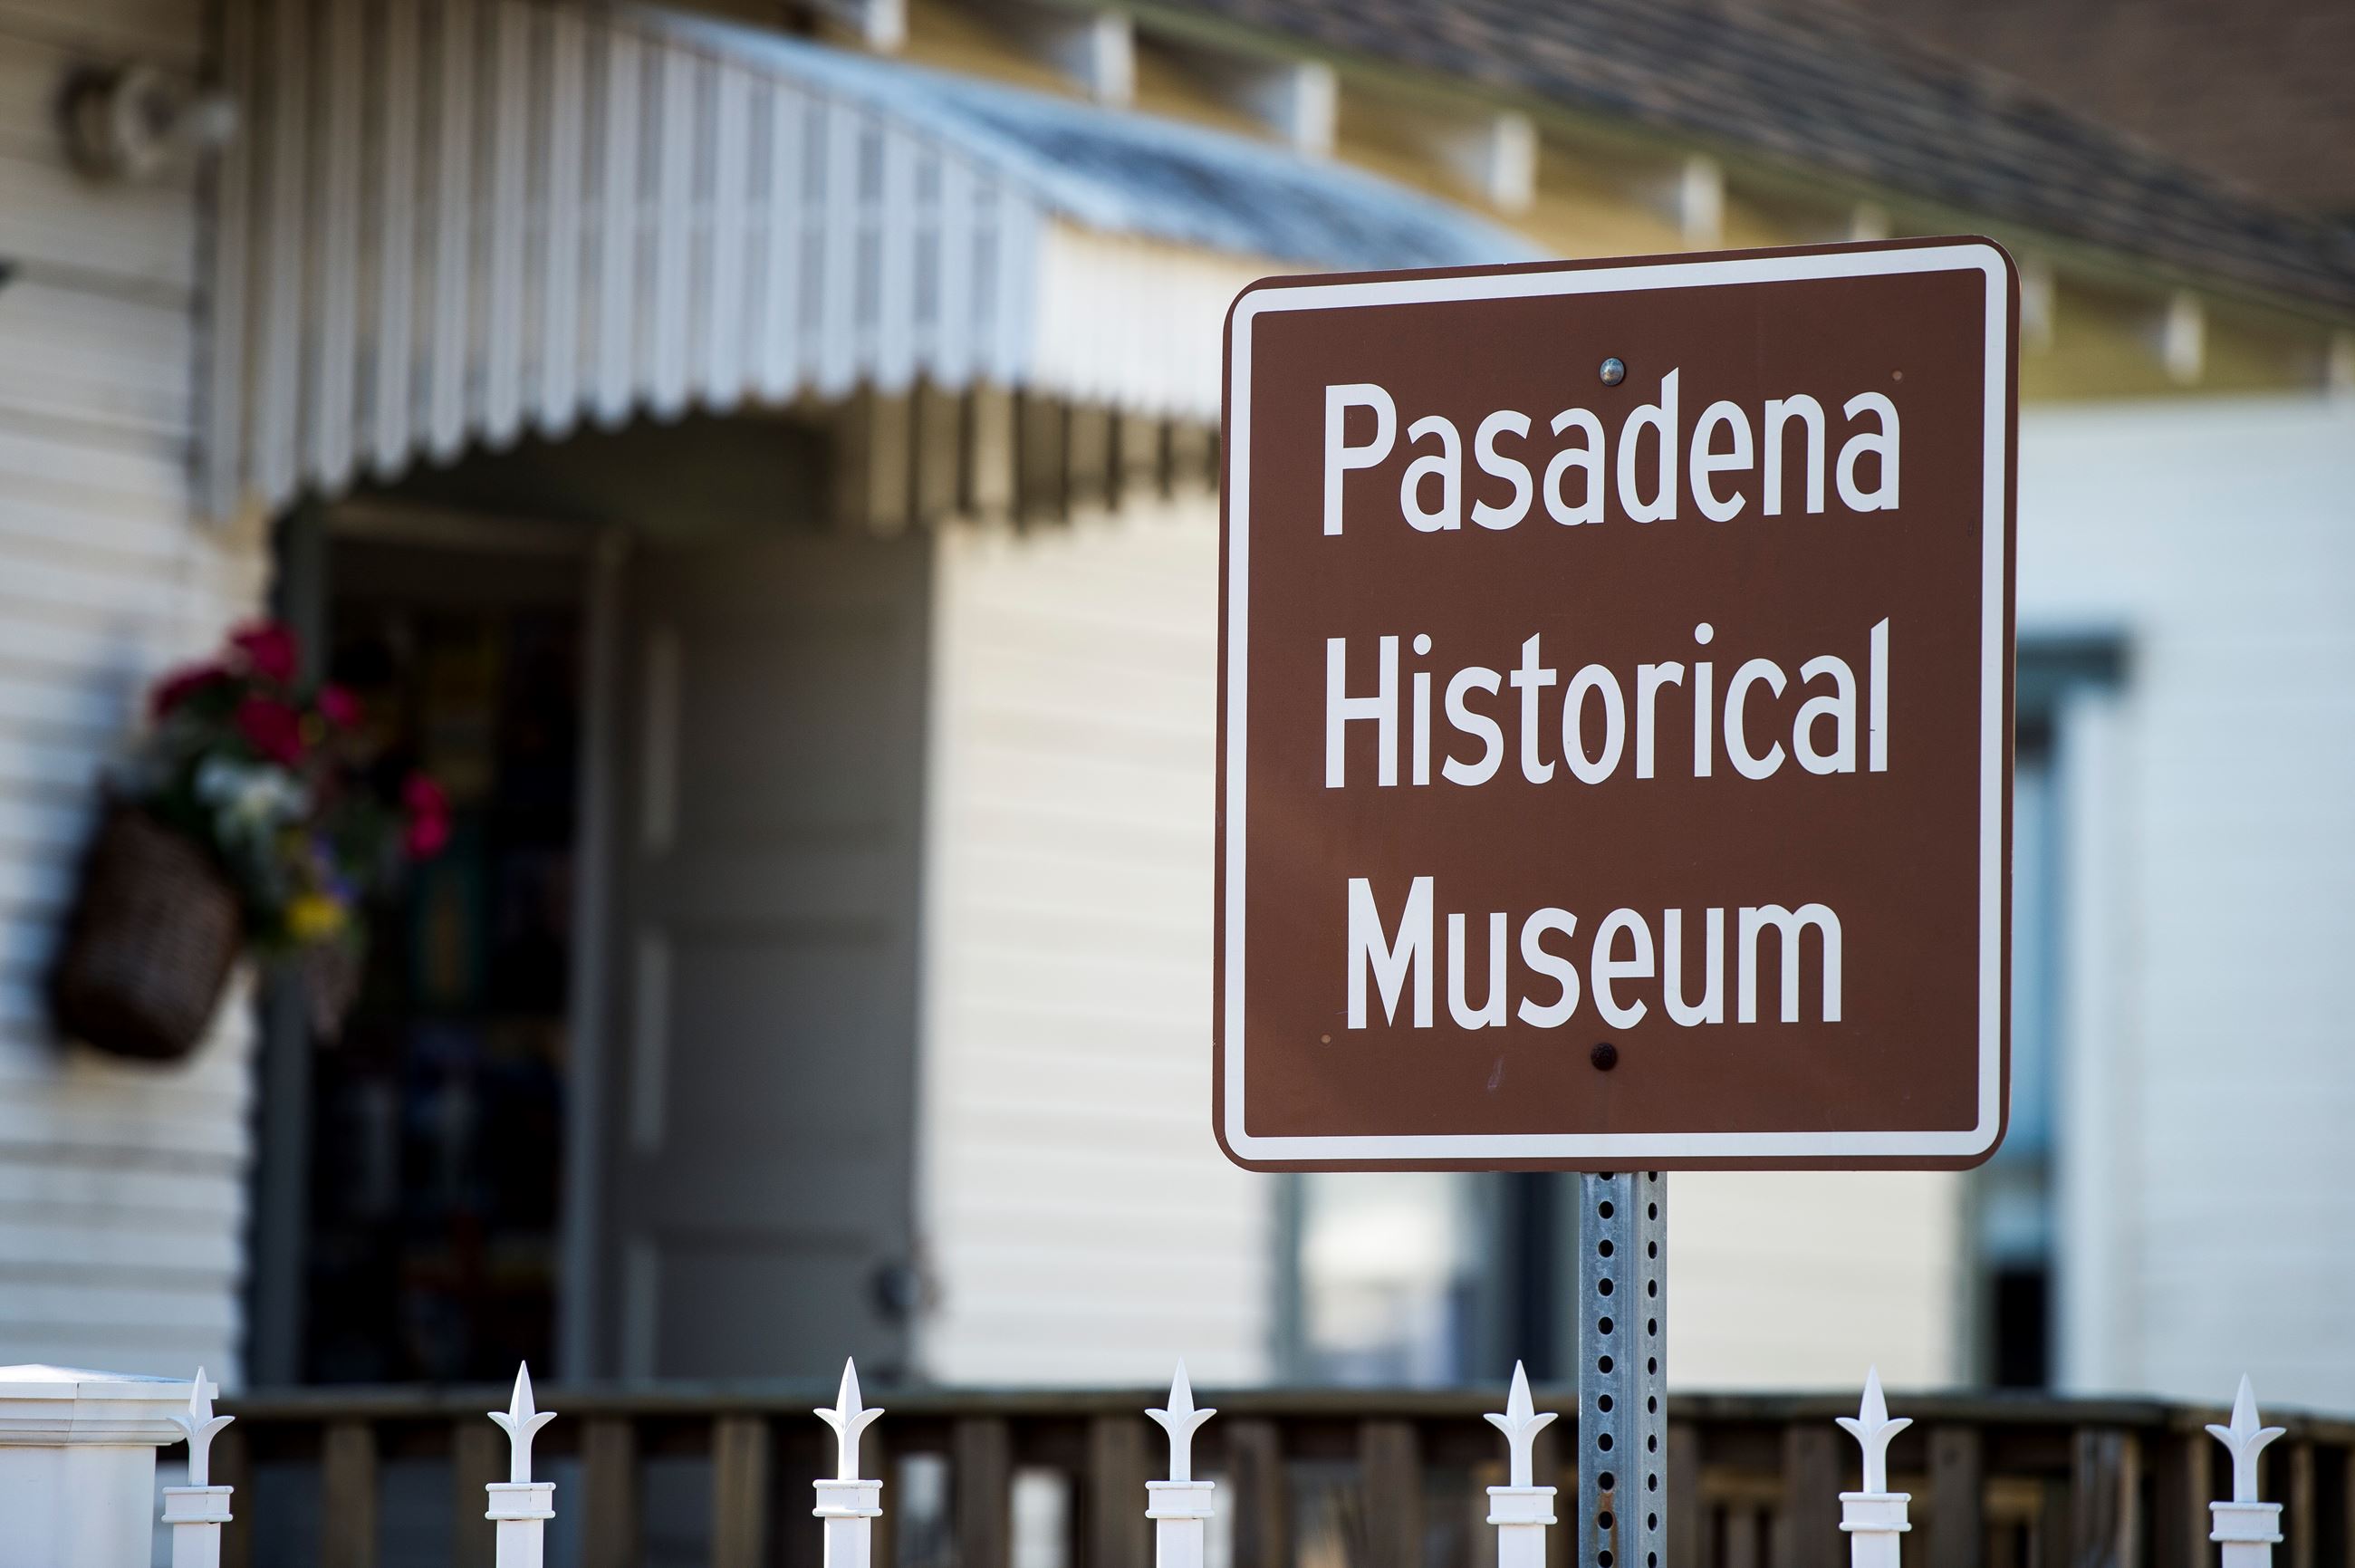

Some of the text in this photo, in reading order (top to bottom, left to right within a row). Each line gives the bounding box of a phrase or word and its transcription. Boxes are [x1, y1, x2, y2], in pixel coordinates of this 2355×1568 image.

[1323, 368, 1900, 536] Pasadena
[1325, 618, 1889, 789] Historical
[1347, 876, 1842, 1031] Museum
